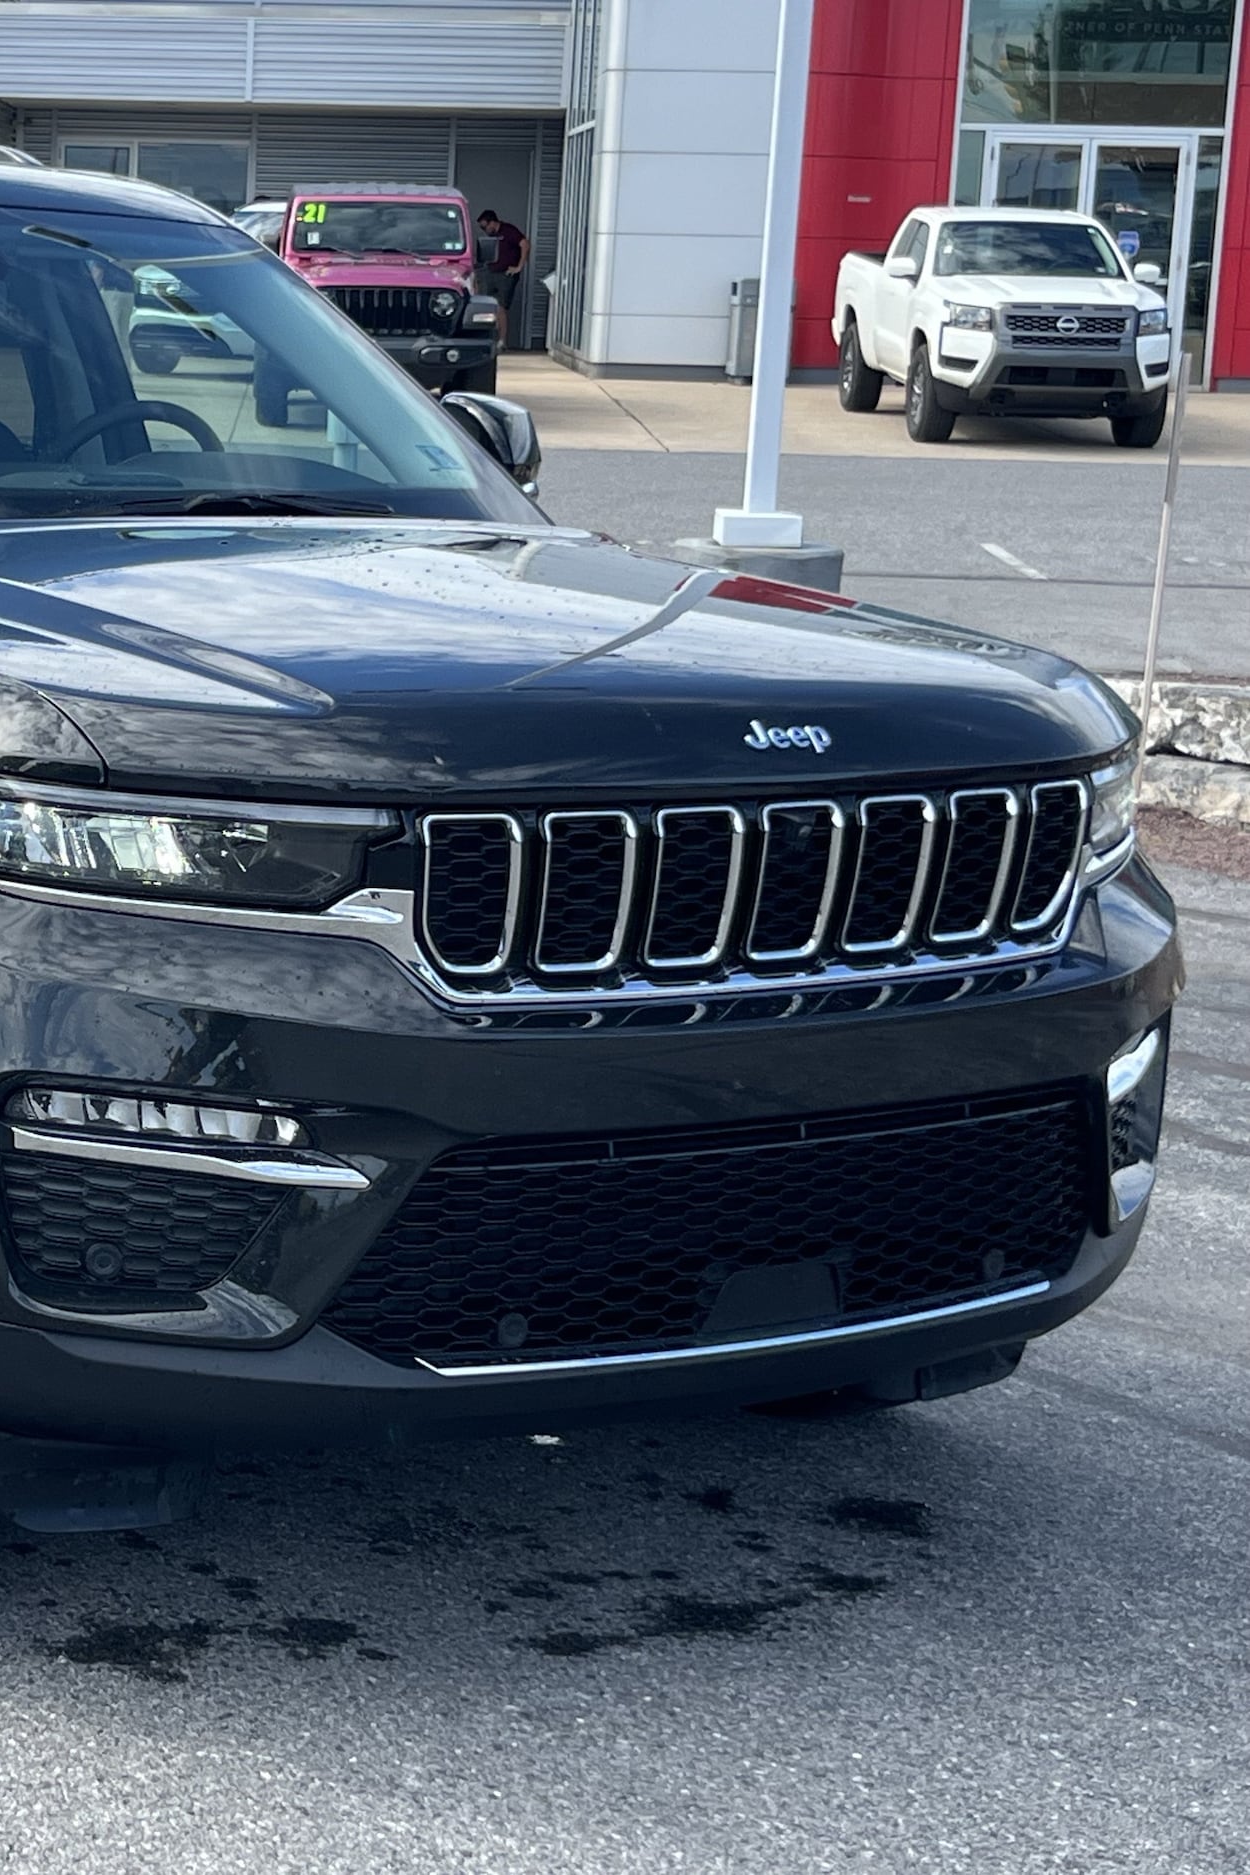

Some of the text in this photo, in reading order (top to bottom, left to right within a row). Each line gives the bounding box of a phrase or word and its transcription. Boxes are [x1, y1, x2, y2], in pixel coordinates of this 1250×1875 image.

[1114, 22, 1135, 33] OF
[1143, 22, 1186, 34] PENN
[303, 203, 327, 224] 21
[743, 718, 832, 753] Jeep
